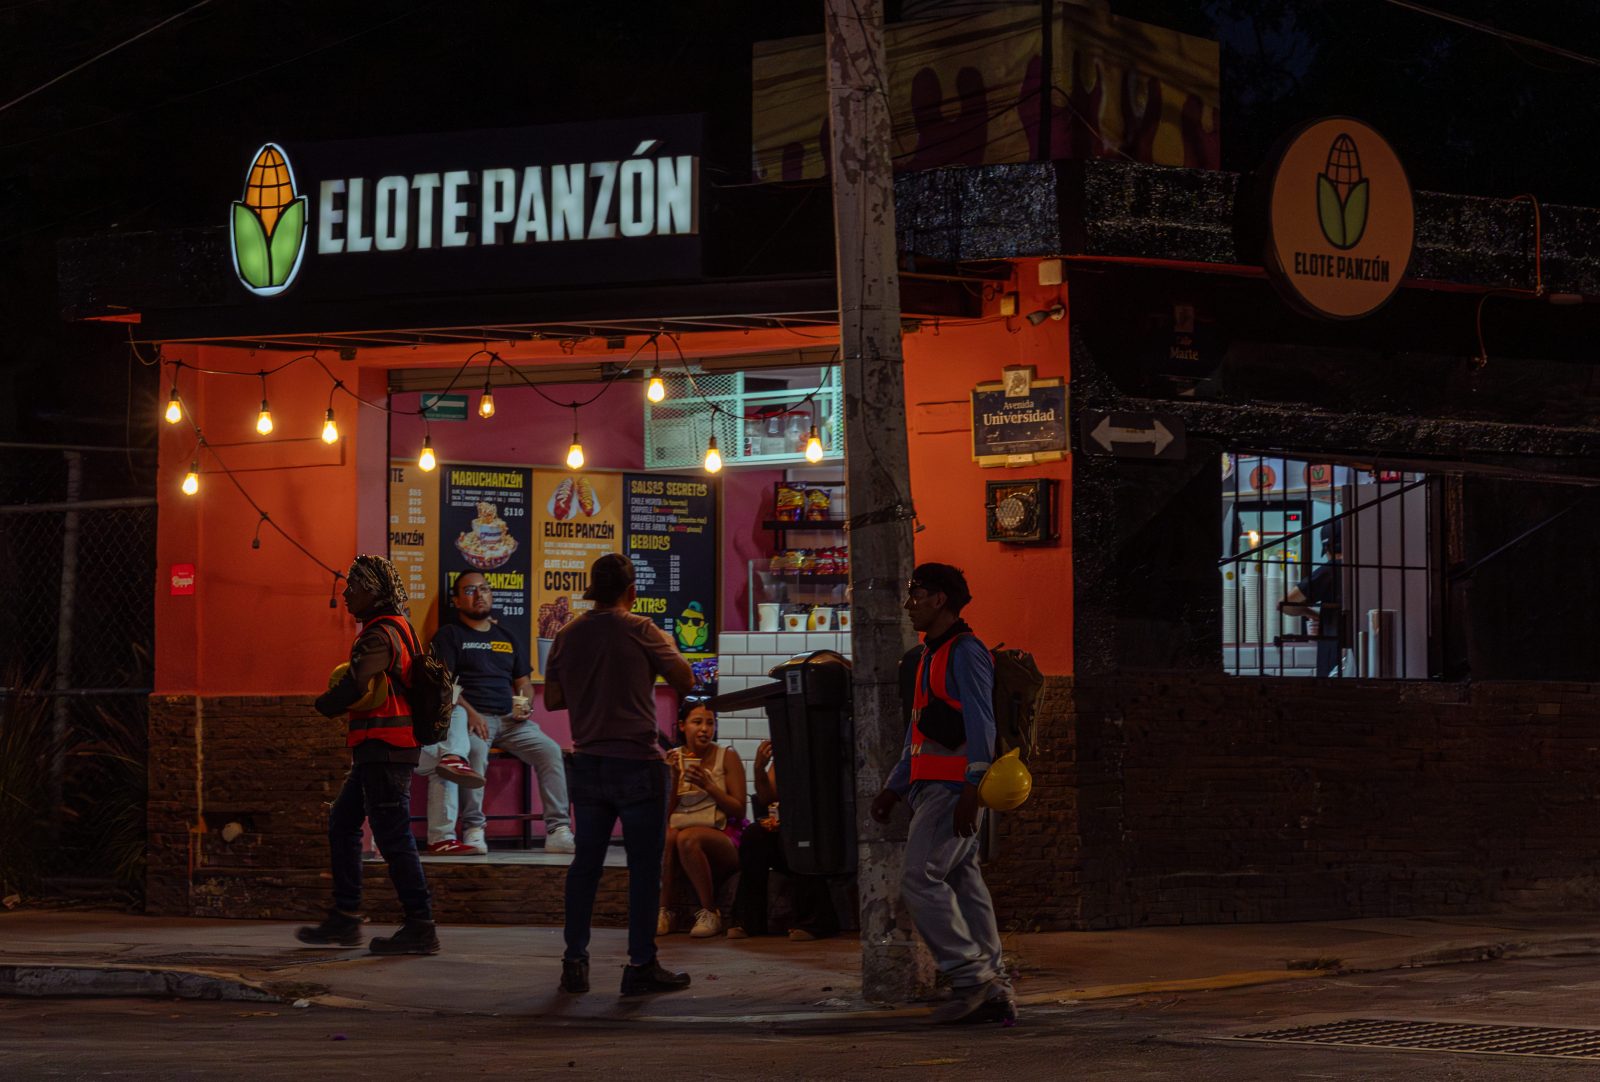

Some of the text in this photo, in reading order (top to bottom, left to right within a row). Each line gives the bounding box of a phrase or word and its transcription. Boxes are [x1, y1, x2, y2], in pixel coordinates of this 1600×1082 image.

[317, 139, 698, 255] ELOTE PANZÓN
[1294, 251, 1390, 283] ELOTE PANZÓN
[1003, 400, 1035, 410] Avenida
[982, 408, 1055, 426] Universidad
[451, 470, 523, 488] MARUCHANZÓN
[504, 507, 524, 517] $110
[544, 520, 615, 540] ELOTE PANZÓN
[544, 570, 587, 592] COSTIL
[503, 606, 524, 616] $110
